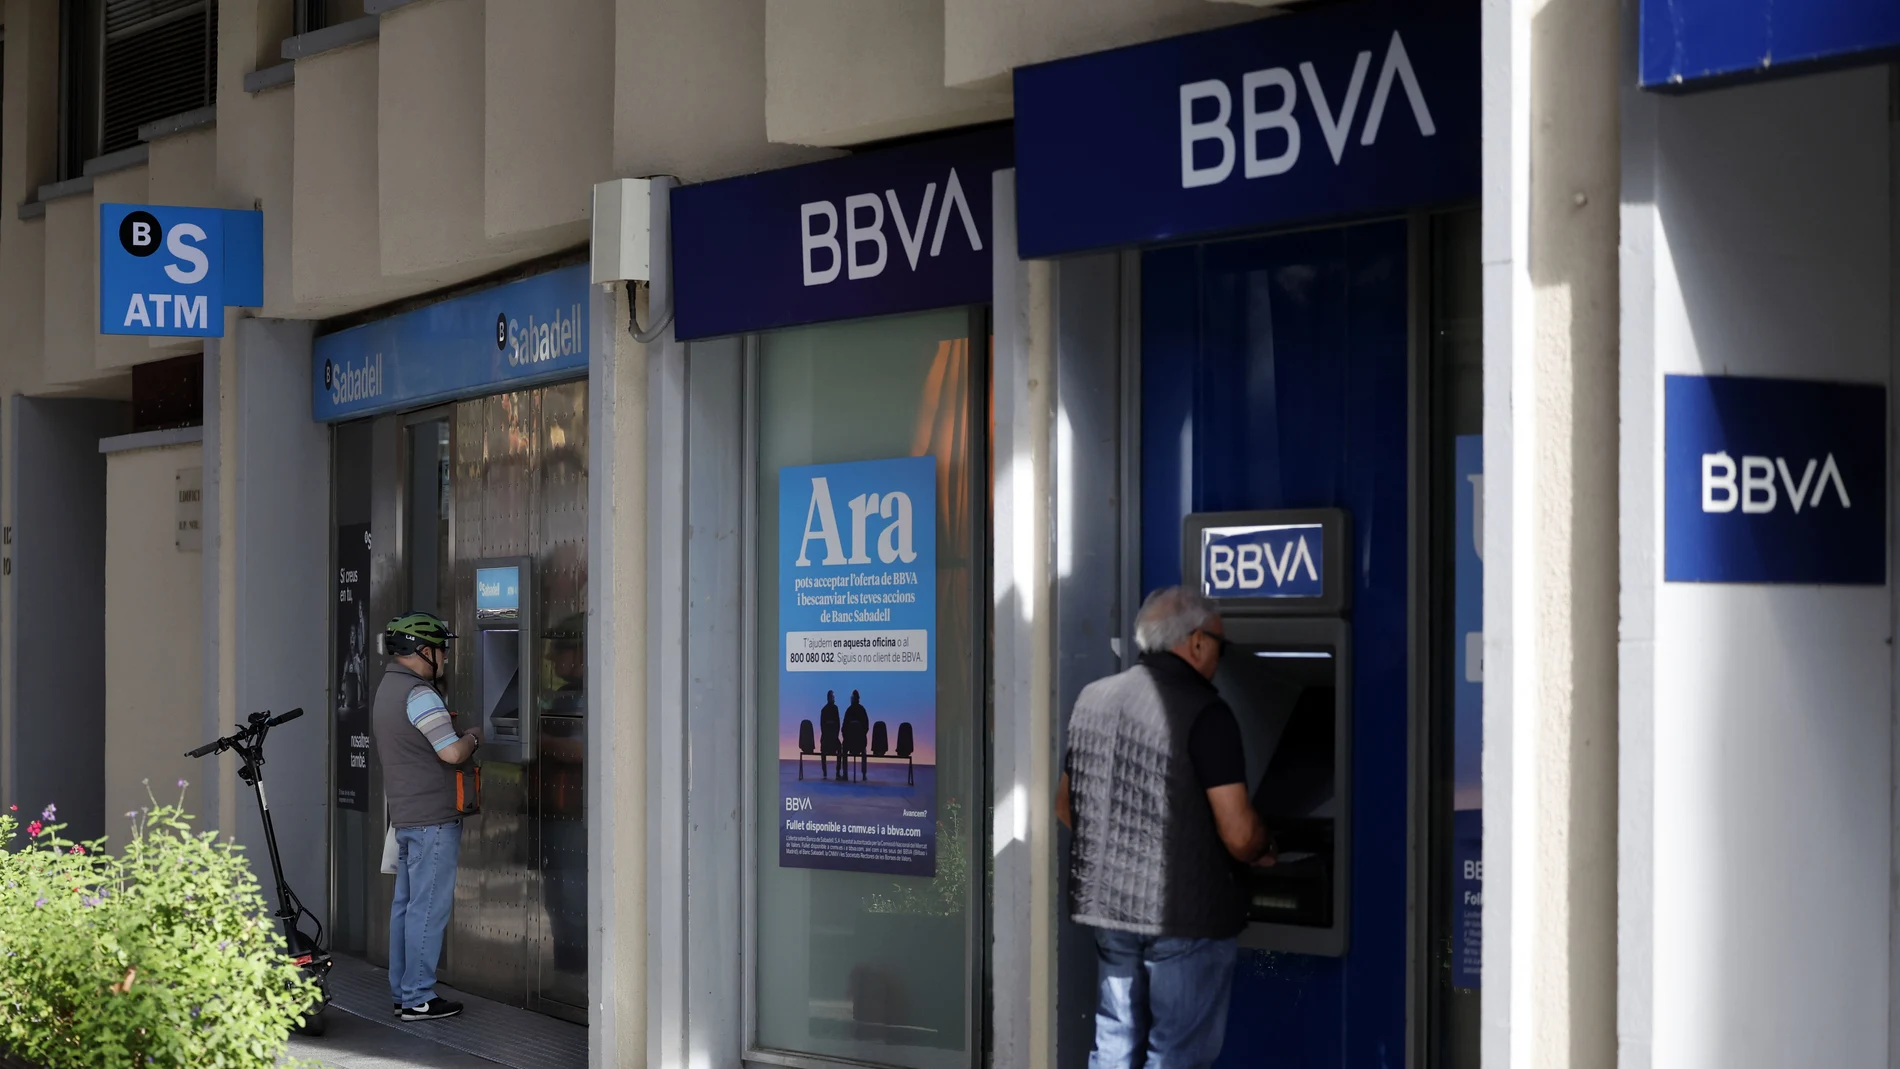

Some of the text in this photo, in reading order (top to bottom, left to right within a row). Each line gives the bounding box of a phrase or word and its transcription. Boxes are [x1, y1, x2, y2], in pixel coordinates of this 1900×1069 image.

[1180, 31, 1436, 189] BBVA
[801, 167, 983, 287] BBVA
[132, 221, 209, 285] B S
[124, 294, 207, 329] ATM
[508, 303, 582, 367] Sabadell
[332, 353, 382, 405] Sabadell
[1702, 452, 1849, 513] BBVA
[796, 477, 917, 567] Ara
[1209, 534, 1318, 589] BBVA
[795, 577, 813, 592] pots
[814, 575, 849, 590] acceptar
[881, 572, 891, 585] de
[892, 571, 918, 585] BBVA
[797, 589, 916, 606] i bescanviar les teves accions
[820, 608, 891, 623] de Banc Sabadell
[790, 653, 804, 663] 800
[805, 653, 820, 663] 080
[837, 652, 856, 665] Siguis
[857, 654, 862, 662] o
[863, 653, 872, 662] no
[873, 652, 891, 662] client
[892, 652, 901, 662] de
[833, 639, 842, 648] en
[843, 638, 871, 650] aquesta
[872, 636, 896, 647] oficina
[897, 639, 902, 647] o
[903, 636, 909, 647] al
[786, 797, 813, 811] BBVA
[903, 809, 927, 818] Avancem?
[786, 819, 805, 831] Fullet
[806, 820, 841, 833] disponible
[848, 824, 876, 835] cnmv.es
[881, 826, 886, 835] a
[887, 825, 921, 837] bbva.com
